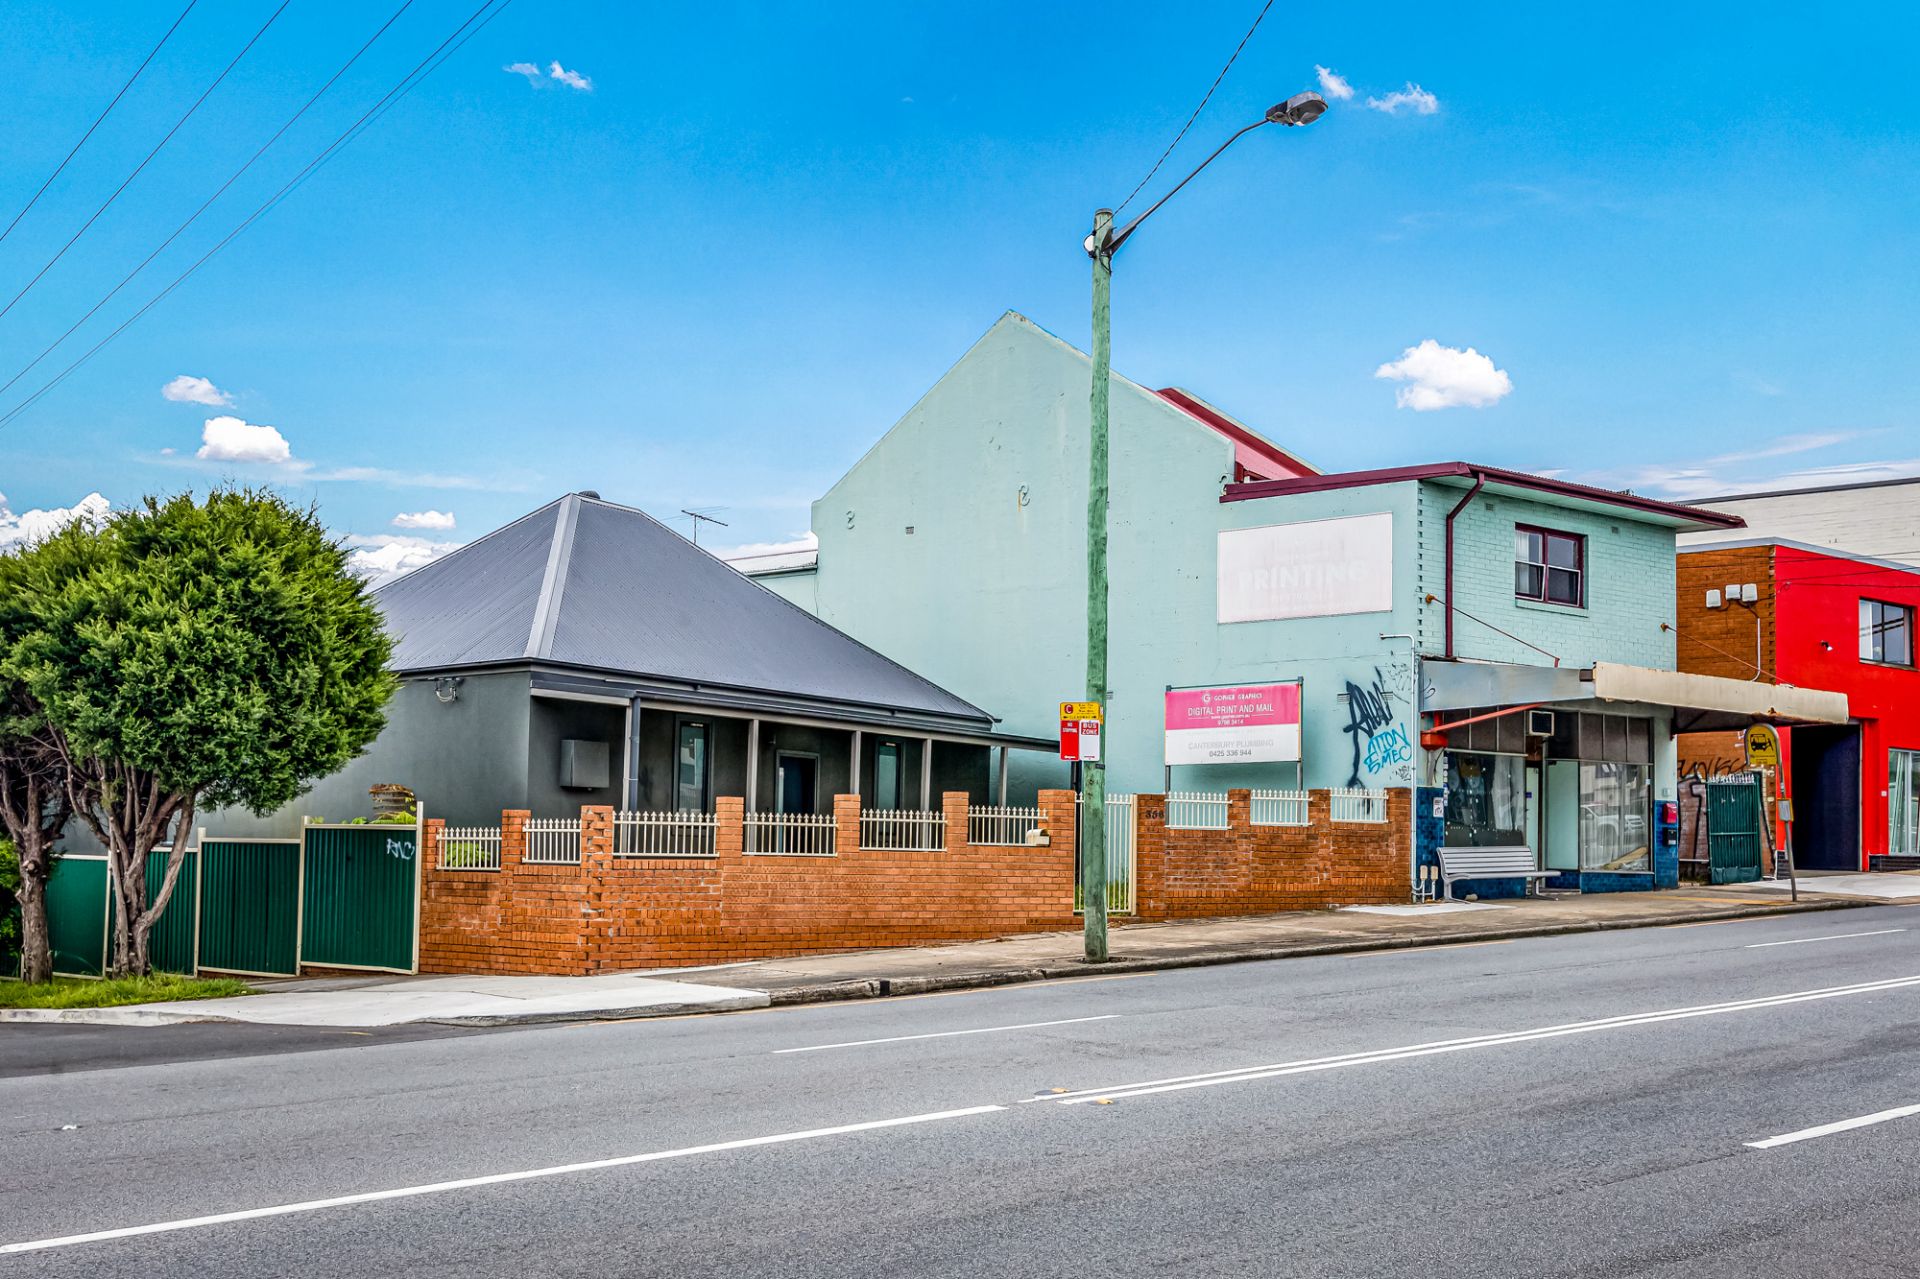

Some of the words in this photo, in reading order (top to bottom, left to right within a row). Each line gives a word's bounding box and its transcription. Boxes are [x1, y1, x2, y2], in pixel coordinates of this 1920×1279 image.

[1188, 707, 1215, 716] DIGITAL
[1216, 705, 1238, 714] PRINT
[1238, 704, 1255, 713] AND
[1256, 703, 1274, 712] MAIL
[1209, 750, 1225, 758] 0425
